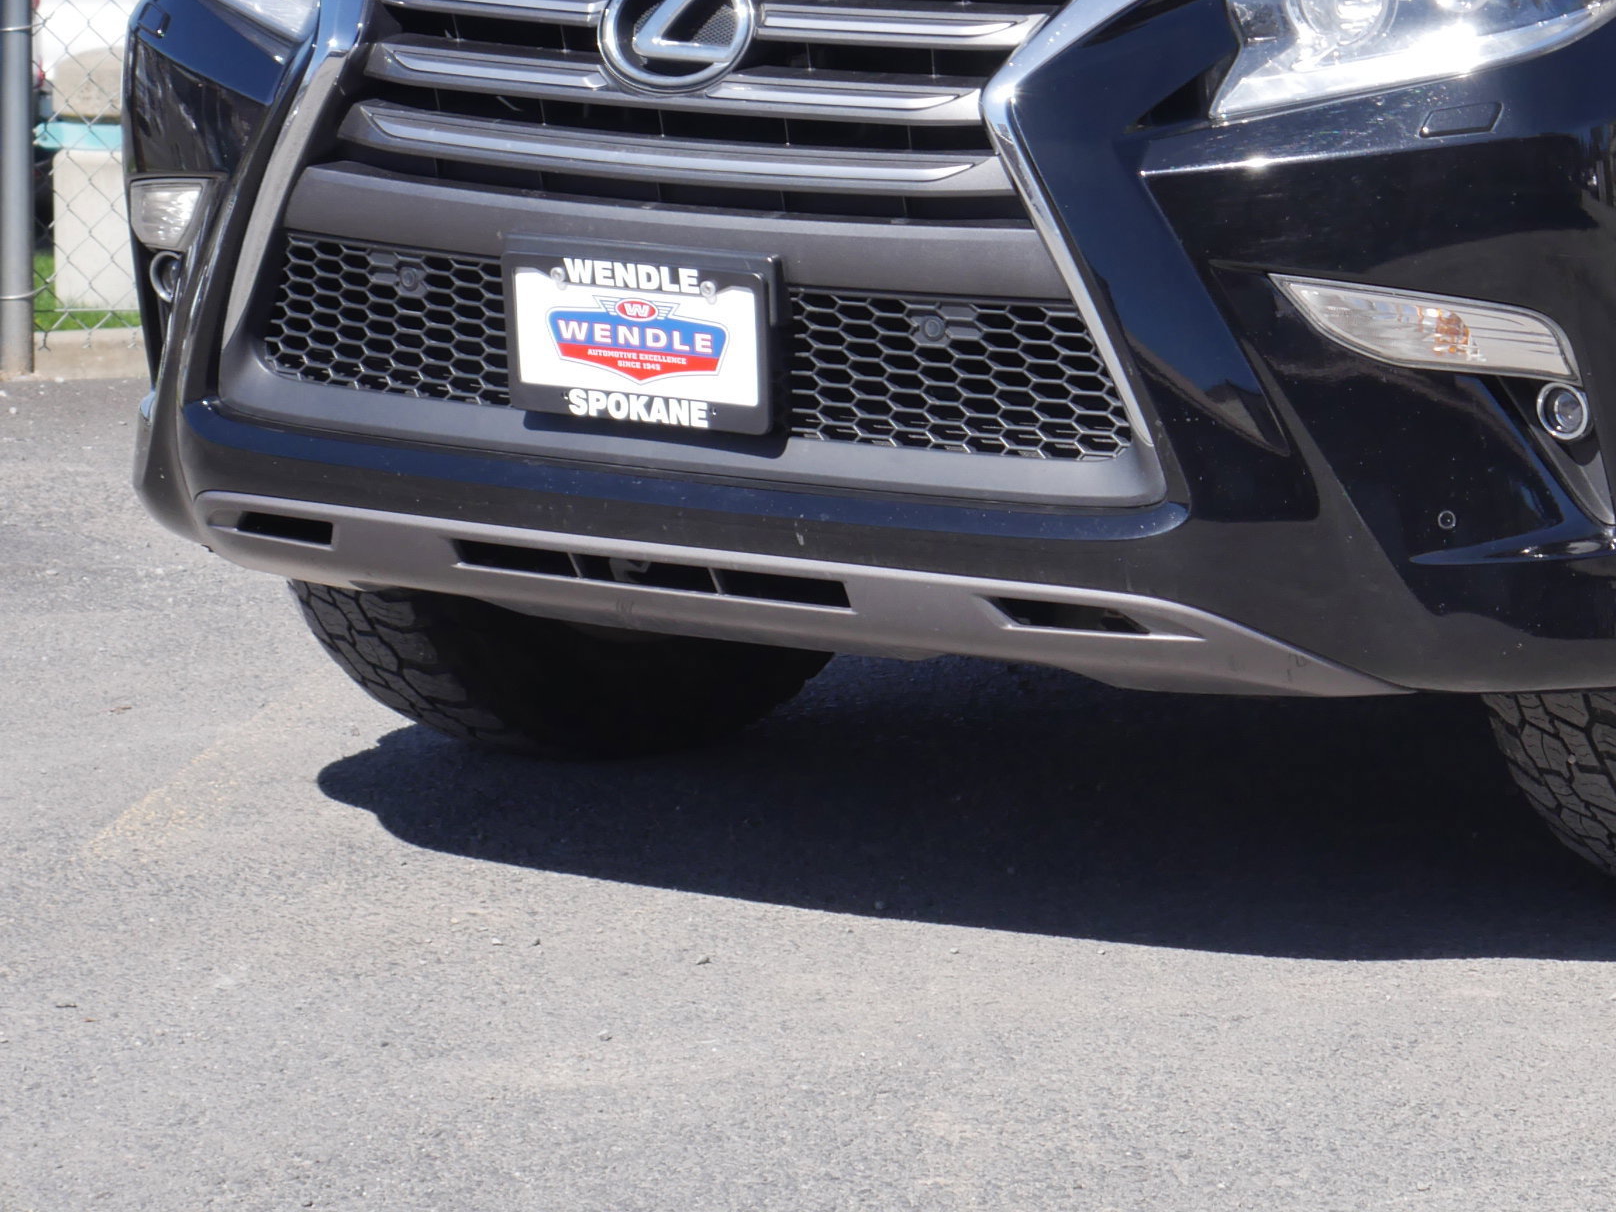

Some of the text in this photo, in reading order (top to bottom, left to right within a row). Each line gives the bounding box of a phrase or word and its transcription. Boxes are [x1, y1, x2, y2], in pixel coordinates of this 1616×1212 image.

[563, 258, 700, 294] WENDLE
[557, 319, 713, 354] WENDLE
[587, 348, 687, 365] AUTOMOTIVE EXCELLENCE
[617, 359, 641, 370] SINCE
[568, 388, 709, 428] SPOKANE
